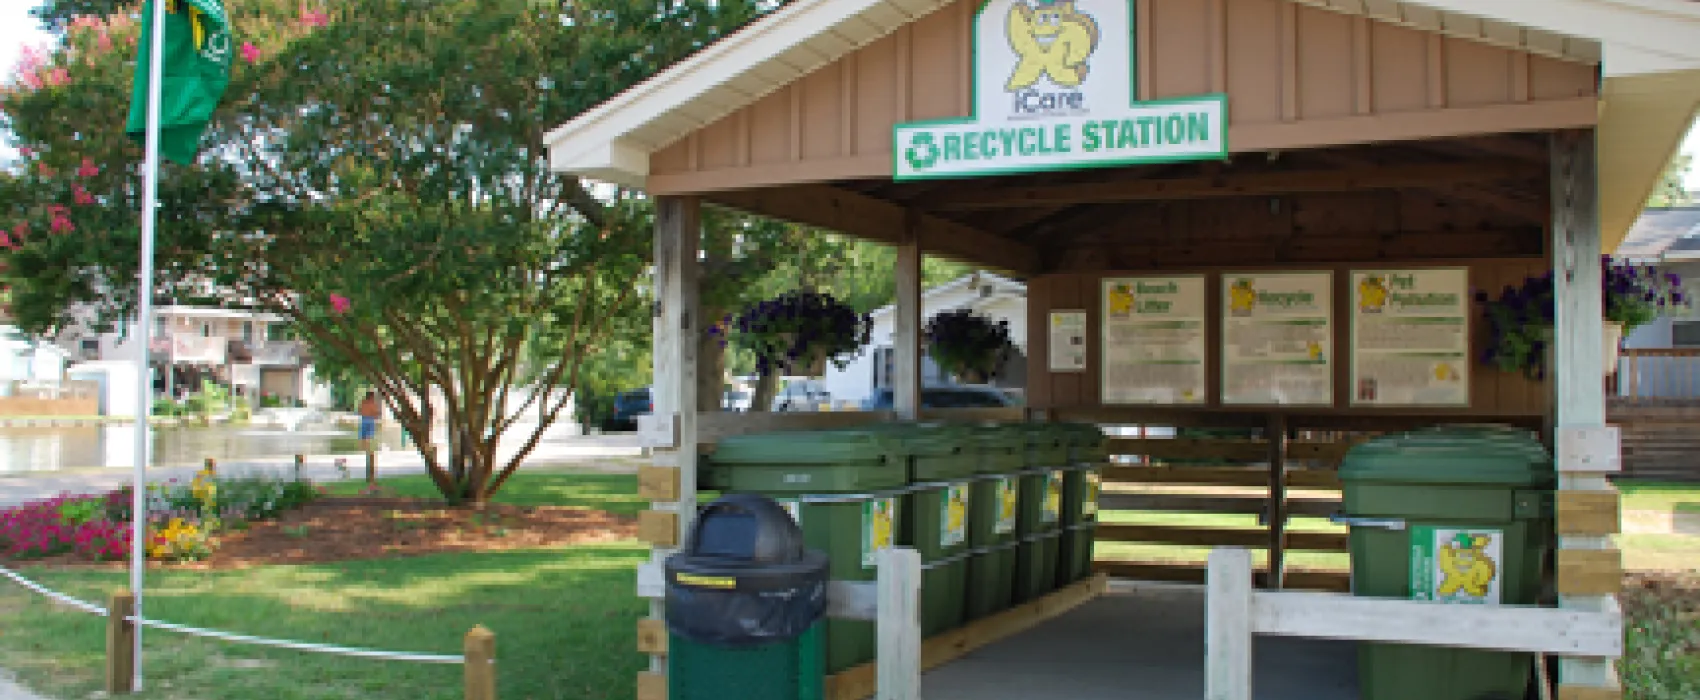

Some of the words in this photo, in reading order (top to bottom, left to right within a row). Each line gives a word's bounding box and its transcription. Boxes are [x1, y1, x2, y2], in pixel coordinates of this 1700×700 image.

[1013, 90, 1084, 114] iCare
[943, 123, 1072, 161] RECYCLE
[1081, 111, 1209, 152] STATION
